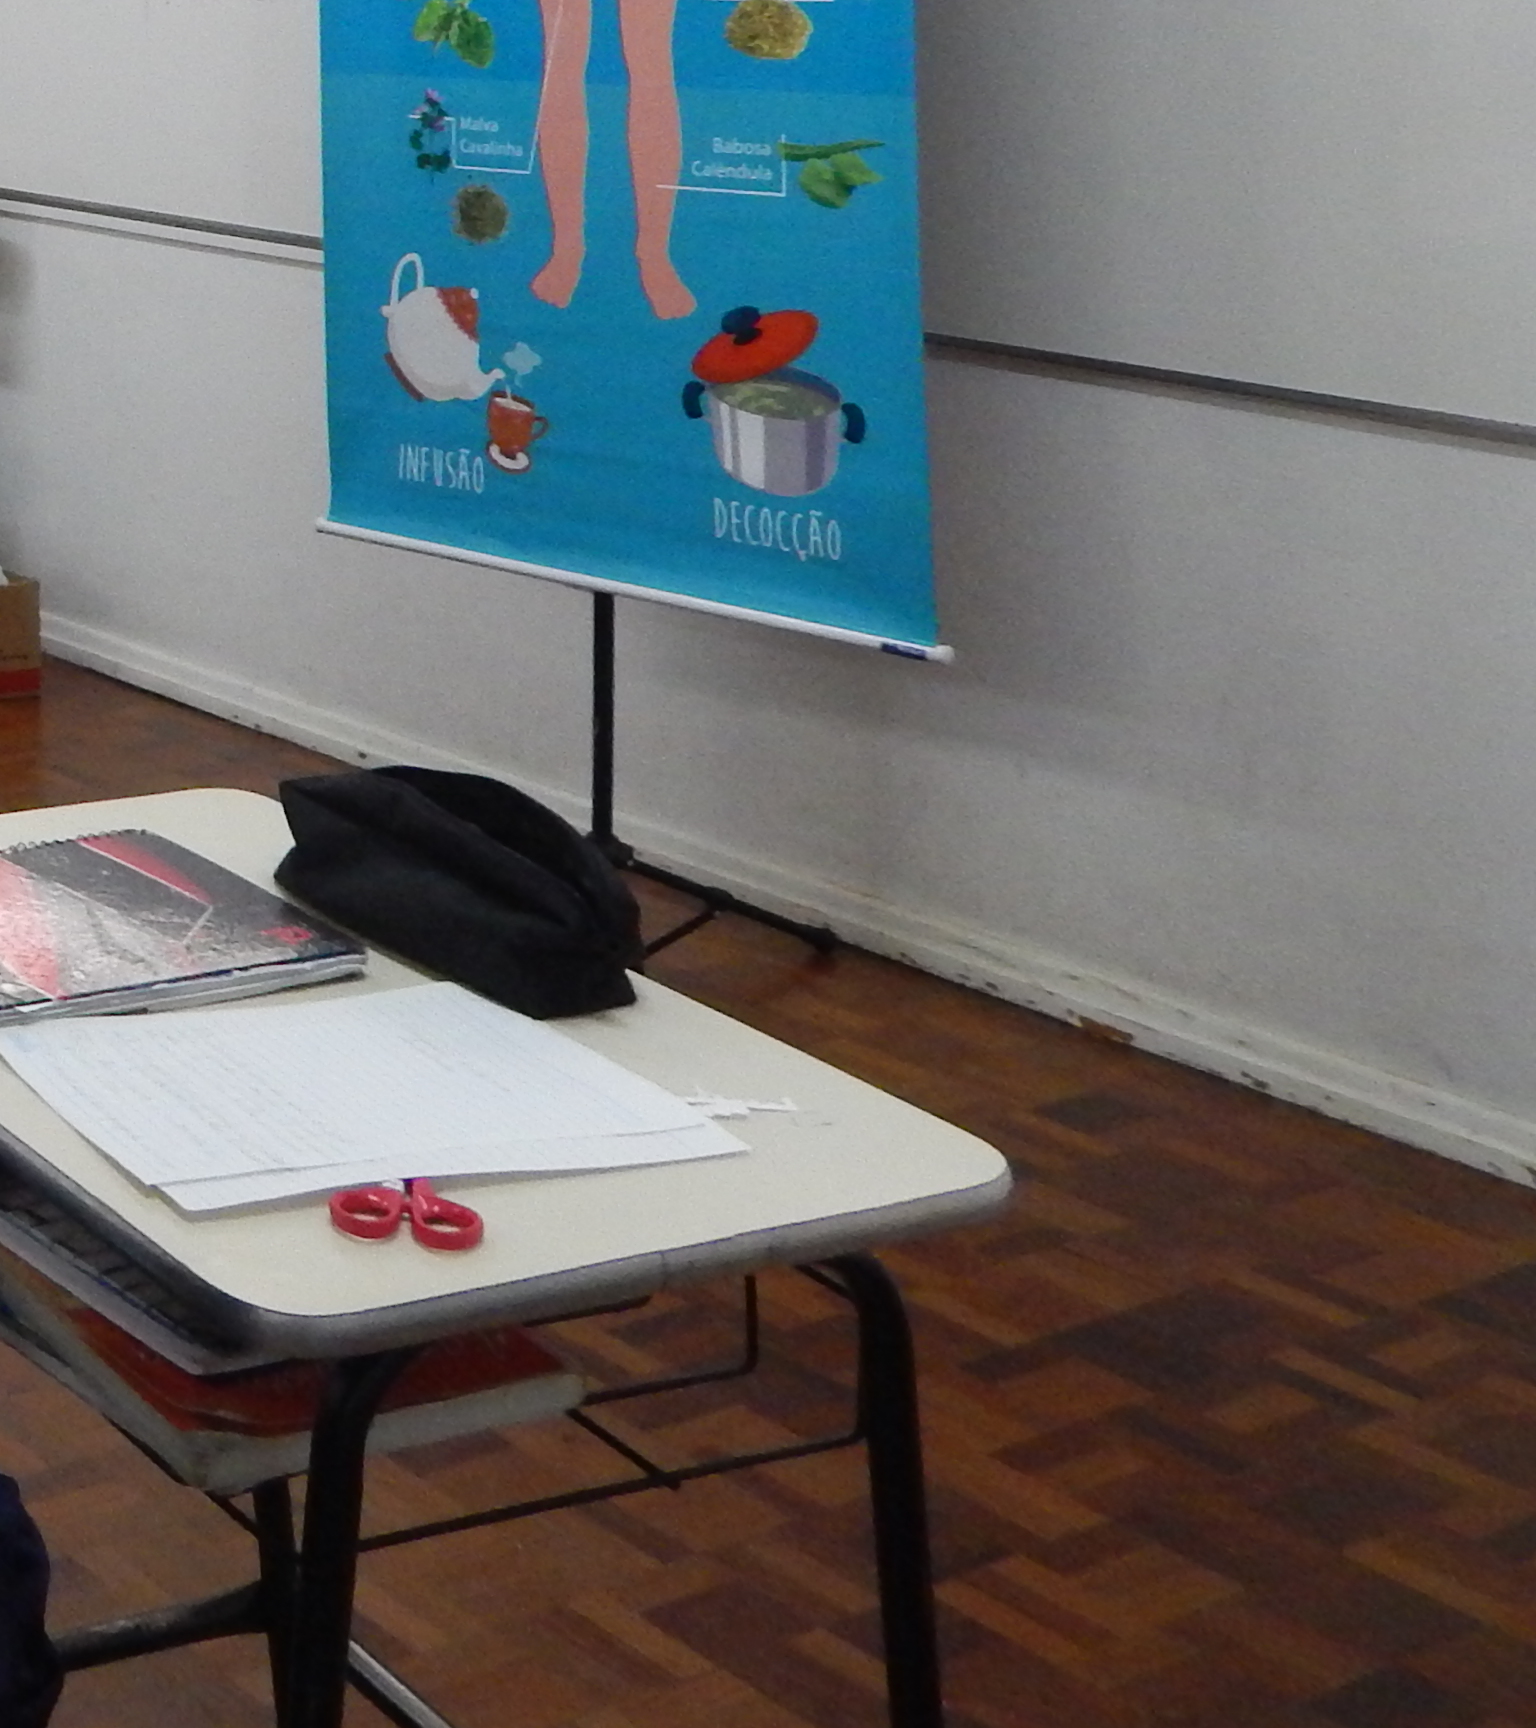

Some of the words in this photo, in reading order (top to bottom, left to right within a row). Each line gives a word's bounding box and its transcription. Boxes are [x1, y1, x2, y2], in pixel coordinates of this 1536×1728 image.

[460, 116, 499, 132] Malva
[712, 137, 772, 156] Babosa
[398, 444, 486, 495] INFUSÃO
[712, 497, 842, 562] DECOCÇÃO
